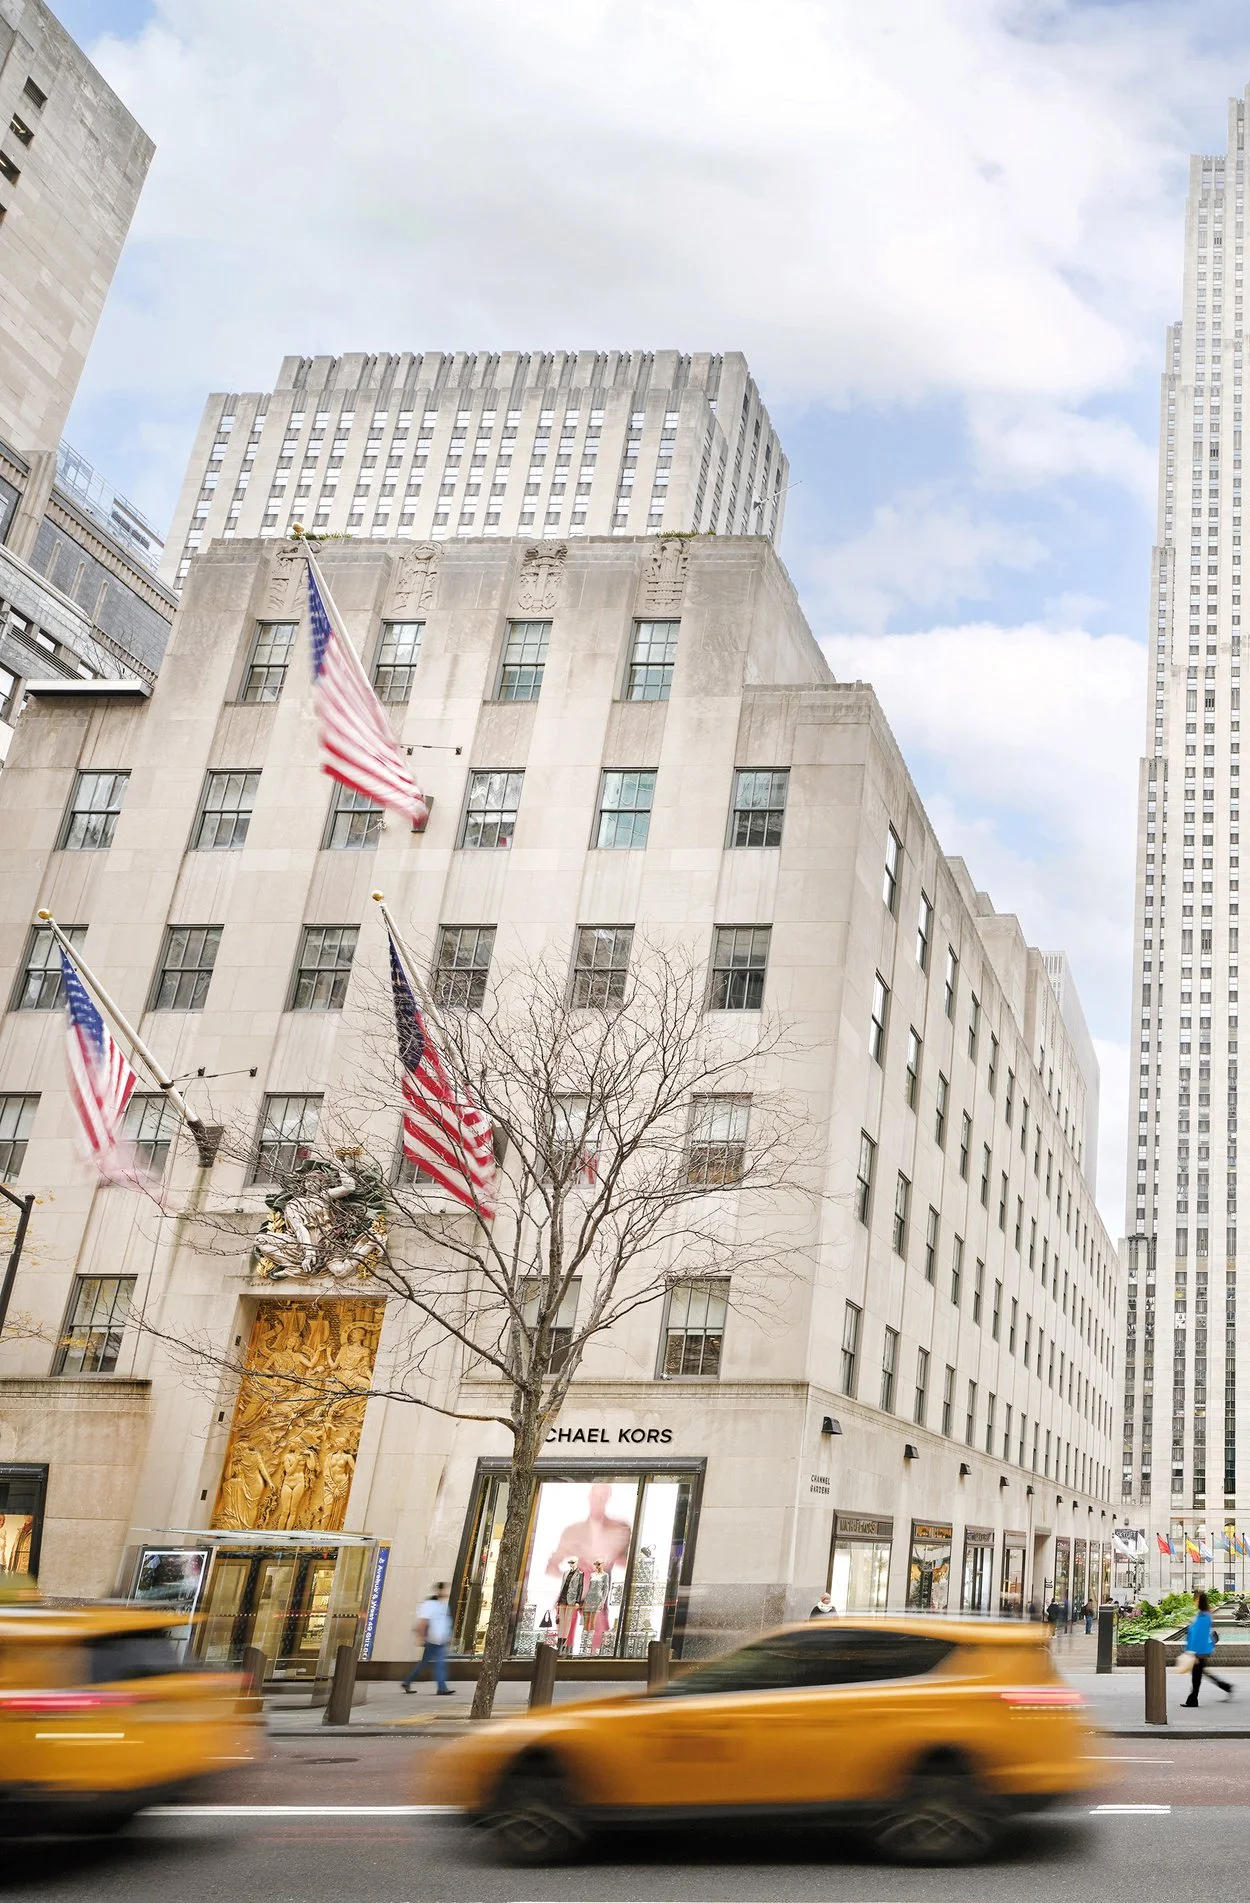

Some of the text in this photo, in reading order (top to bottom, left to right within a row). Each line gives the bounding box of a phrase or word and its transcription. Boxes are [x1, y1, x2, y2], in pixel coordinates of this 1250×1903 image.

[545, 1428, 673, 1443] CHAEL KORS
[811, 1474, 830, 1485] CHANNEL
[810, 1485, 830, 1494] GARDENS
